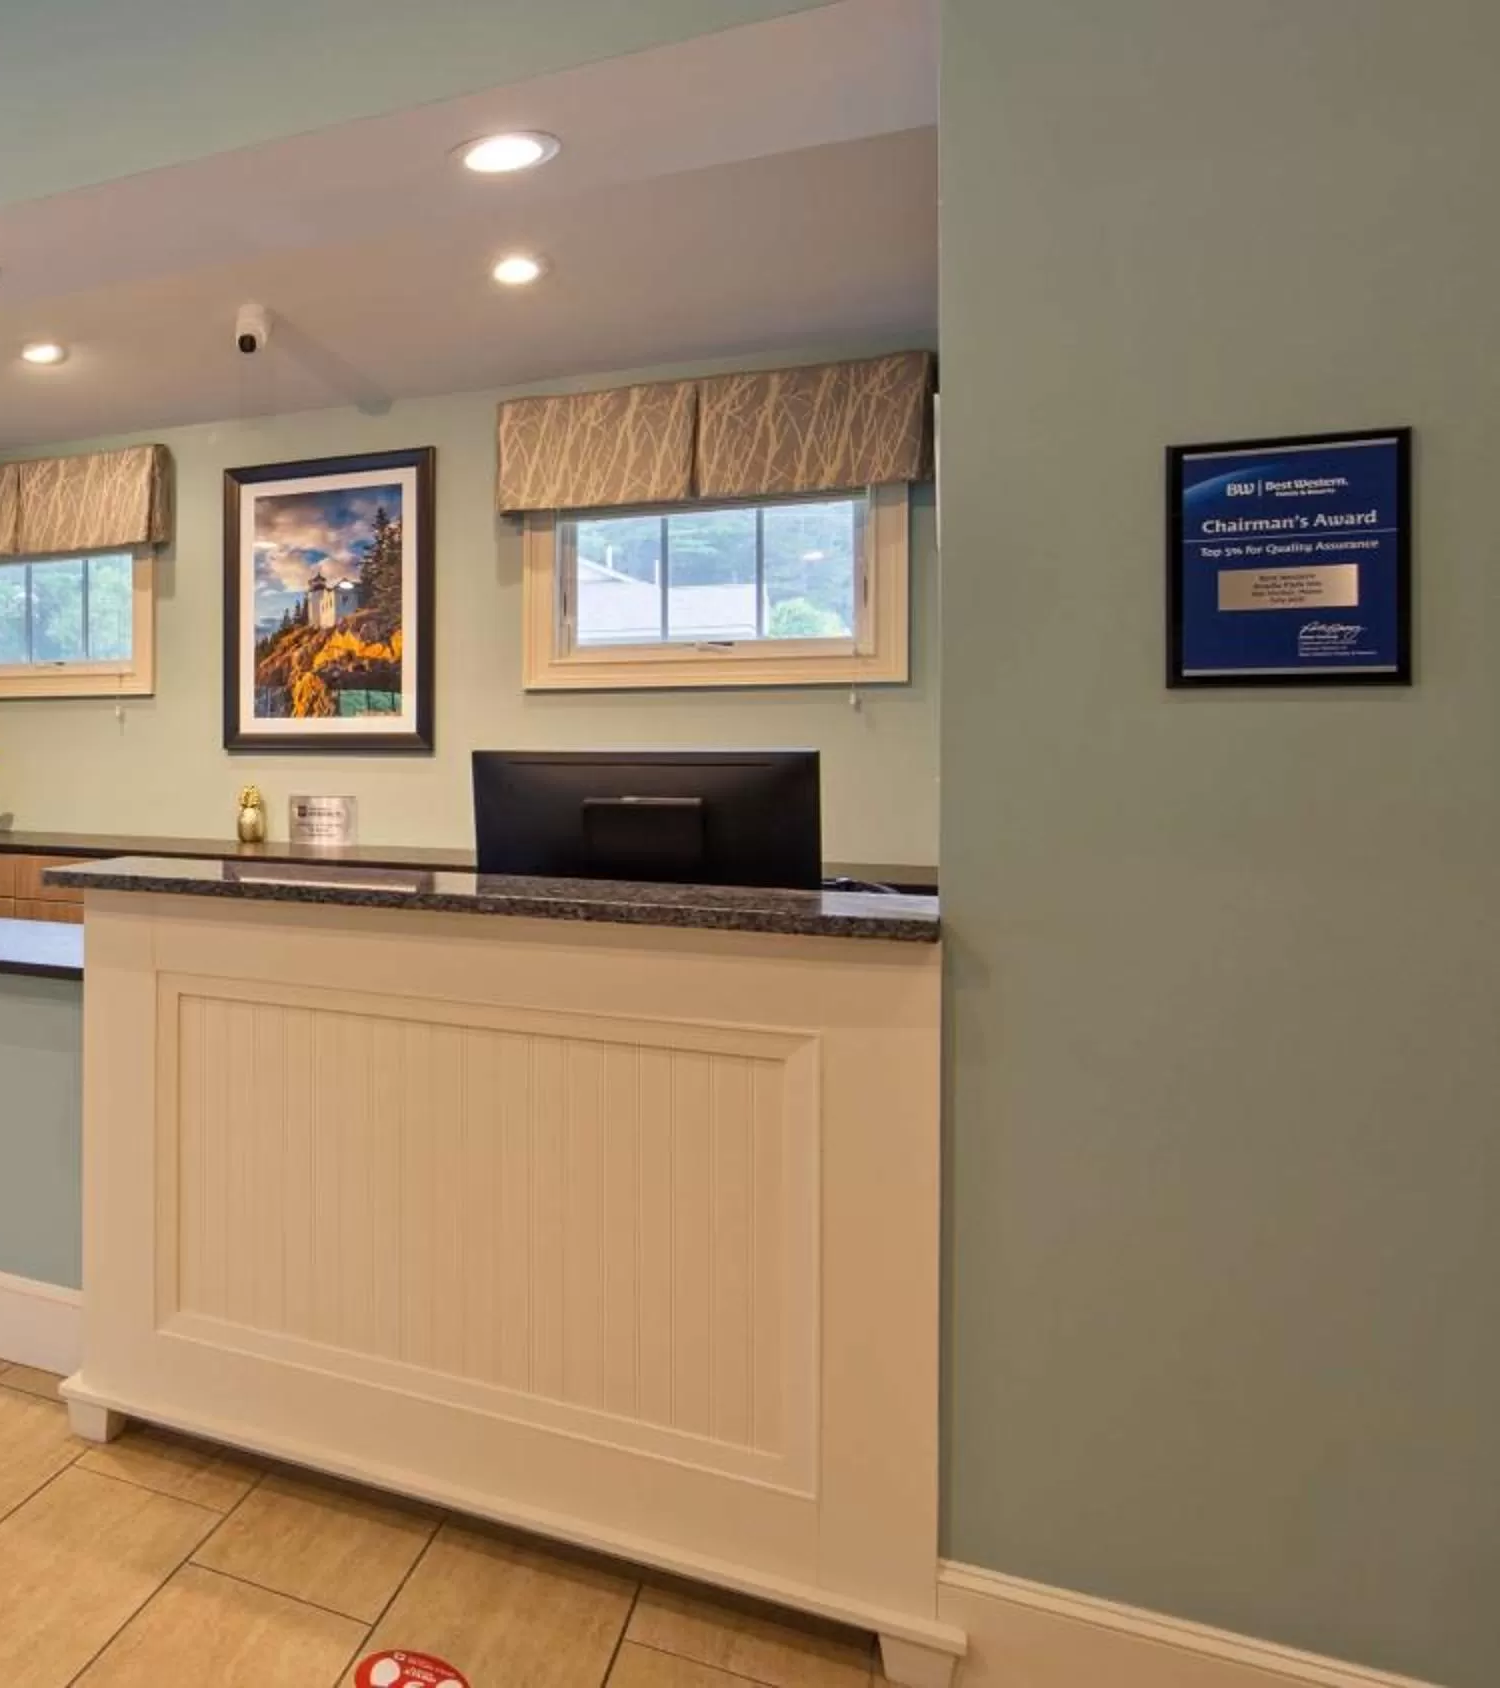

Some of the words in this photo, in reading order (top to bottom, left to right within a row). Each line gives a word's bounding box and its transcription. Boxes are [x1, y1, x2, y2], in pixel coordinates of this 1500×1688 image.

[1265, 480, 1292, 491] Best
[1202, 514, 1309, 534] Chairman's
[1313, 509, 1378, 527] Award
[1201, 547, 1221, 558] Top
[1224, 547, 1243, 557] 5%
[1245, 545, 1262, 555] for
[1265, 542, 1313, 554] Quality
[1315, 539, 1380, 551] Assurance
